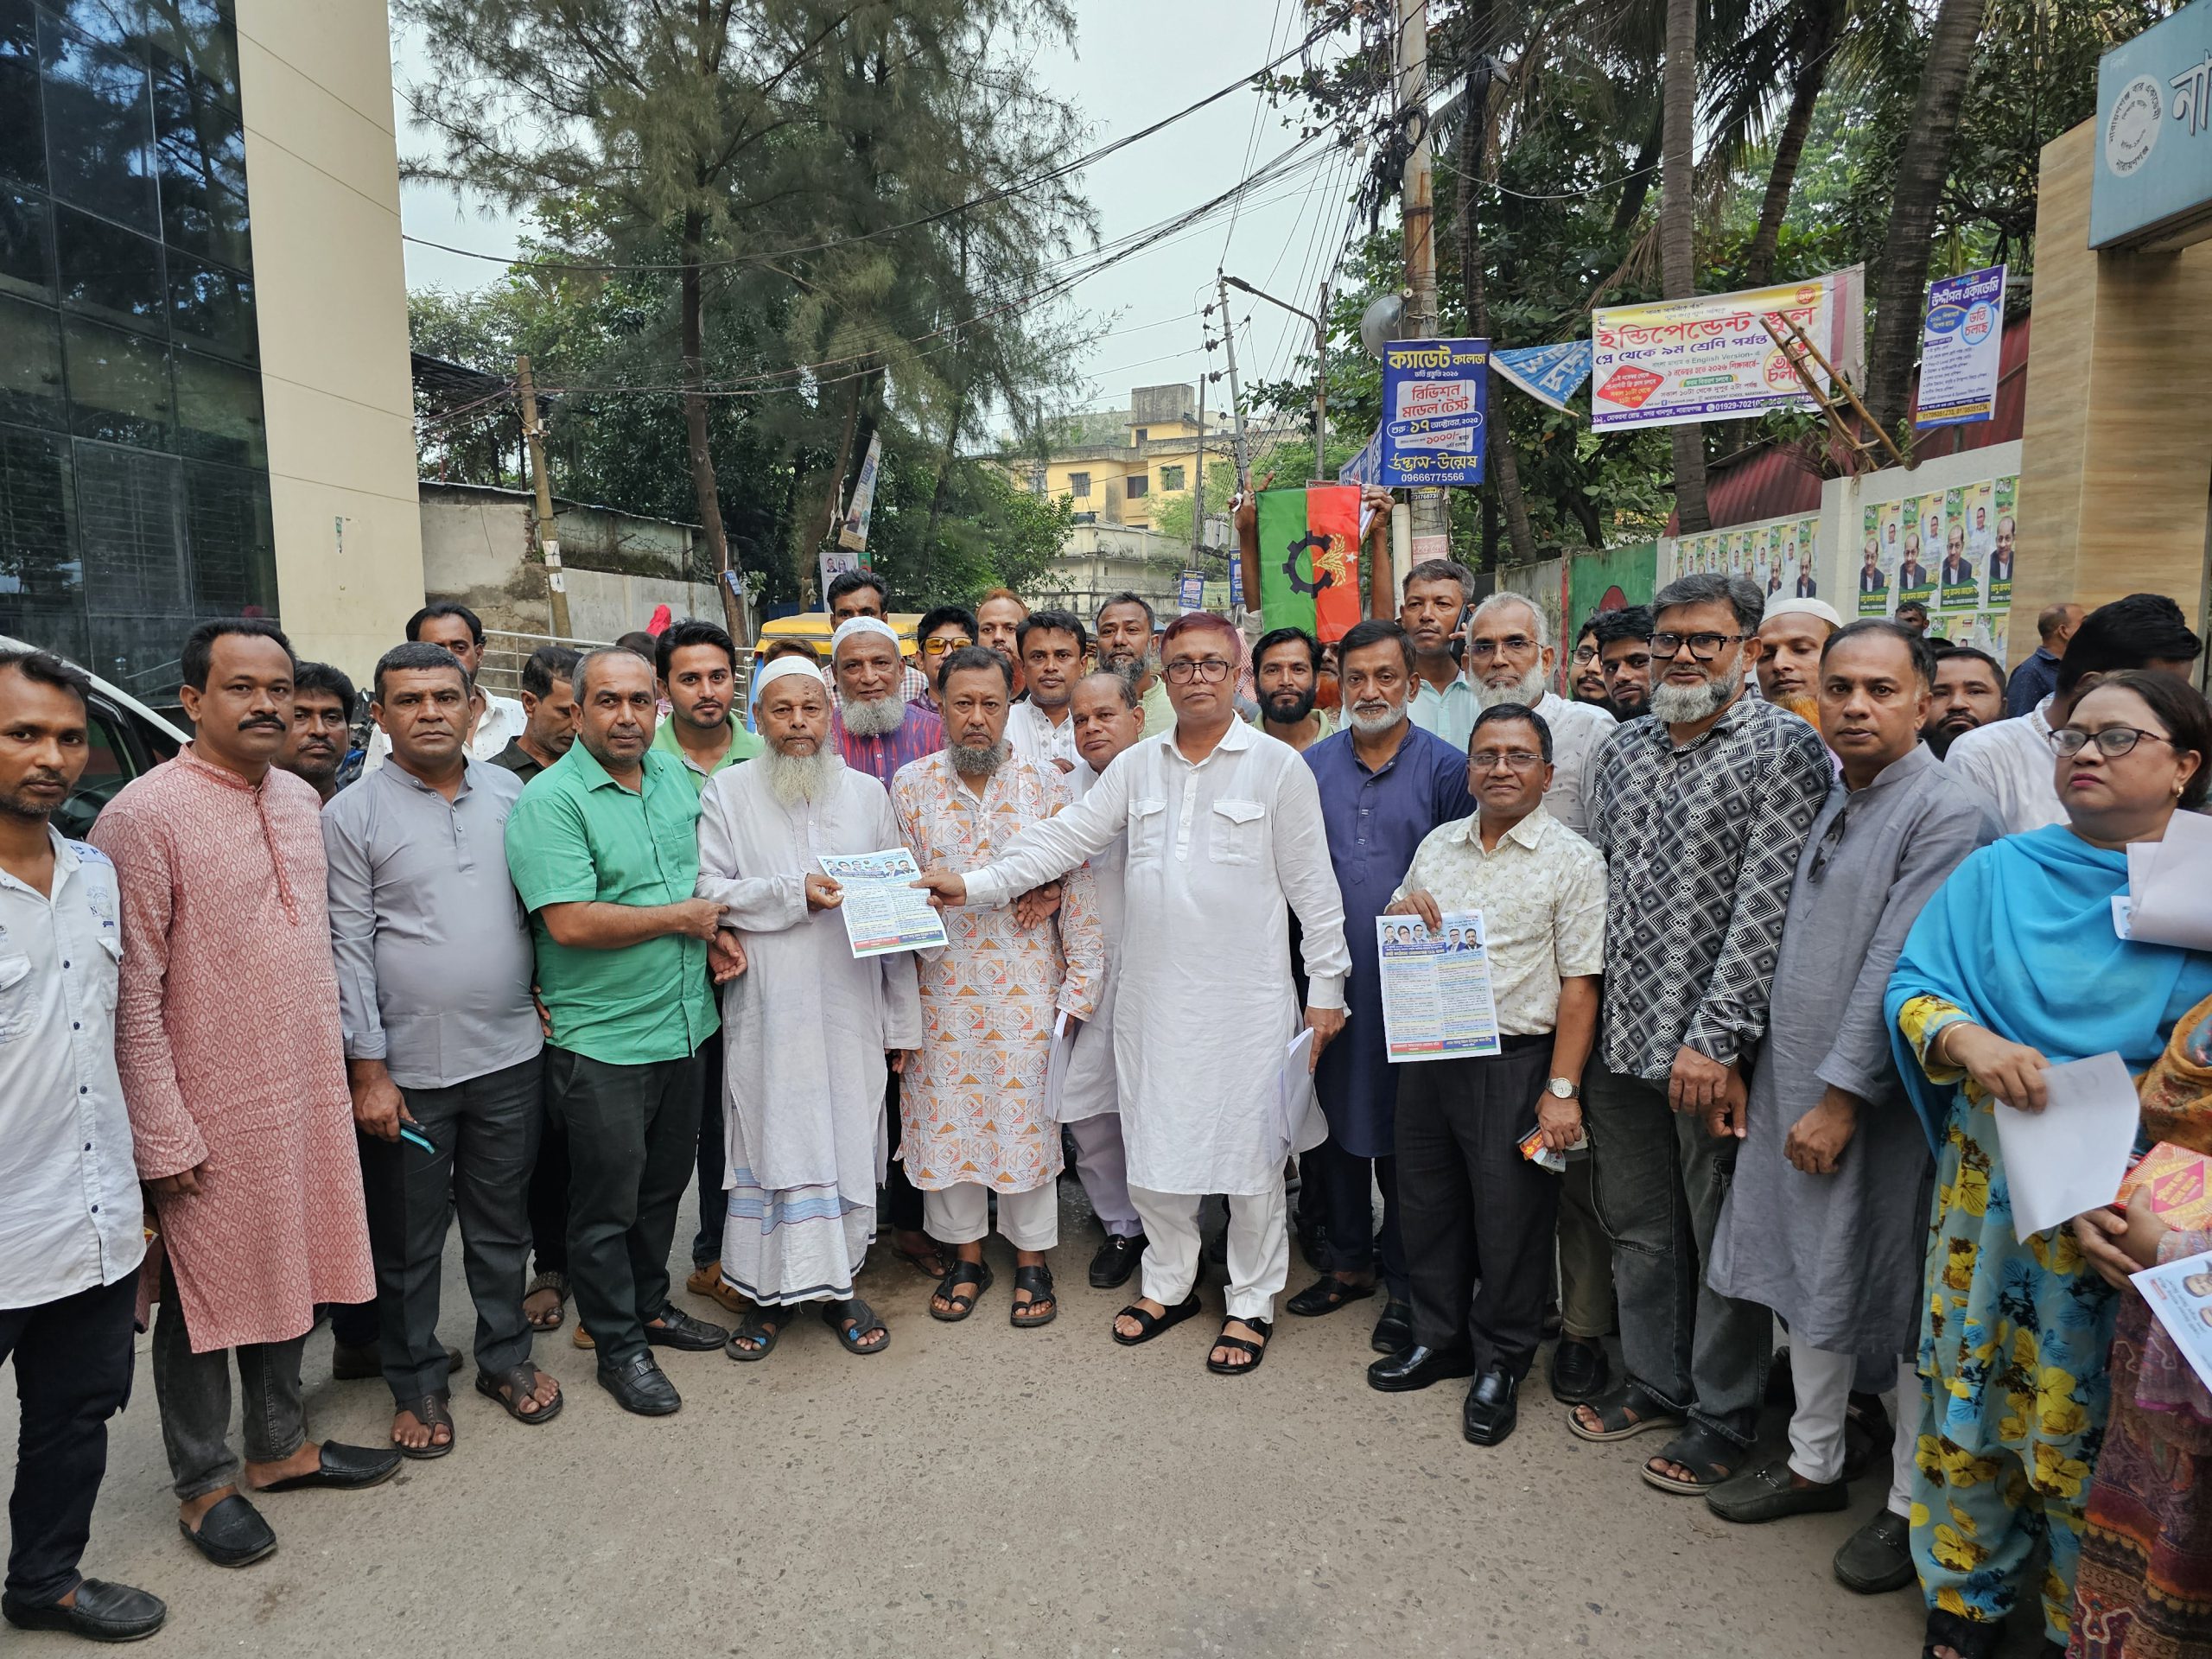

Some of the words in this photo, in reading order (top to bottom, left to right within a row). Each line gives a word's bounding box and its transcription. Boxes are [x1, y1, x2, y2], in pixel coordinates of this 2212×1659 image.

[1931, 289, 1962, 307] উদ্দীপন
[1963, 276, 1999, 299] একাডেমি
[1970, 306, 1986, 322] ভর্তি
[1596, 311, 1756, 350] ইন্ডিপেন্ডেন্ট
[1964, 322, 1989, 336] চলছে
[1388, 345, 1452, 370] ক্যাডেট
[1452, 353, 1486, 365] কলেজ
[1596, 353, 1613, 365] প্লে
[1618, 348, 1656, 361] থেকে
[1662, 345, 1684, 354] ৯ম
[1690, 337, 1726, 353] শ্রেণি
[1732, 334, 1768, 346] পর্যন্ত
[1692, 354, 1719, 364] English
[1708, 364, 1727, 372] ২০২৬
[1412, 384, 1461, 402] রিভিশন
[1679, 386, 1694, 396] ১০টা
[1696, 386, 1712, 395] থেকে
[1714, 385, 1728, 394] দুপুর
[1402, 403, 1438, 418] মডেল
[1441, 397, 1470, 412] টেস্ট
[1410, 419, 1430, 434] ১৭
[1401, 473, 1465, 482] 09666775566
